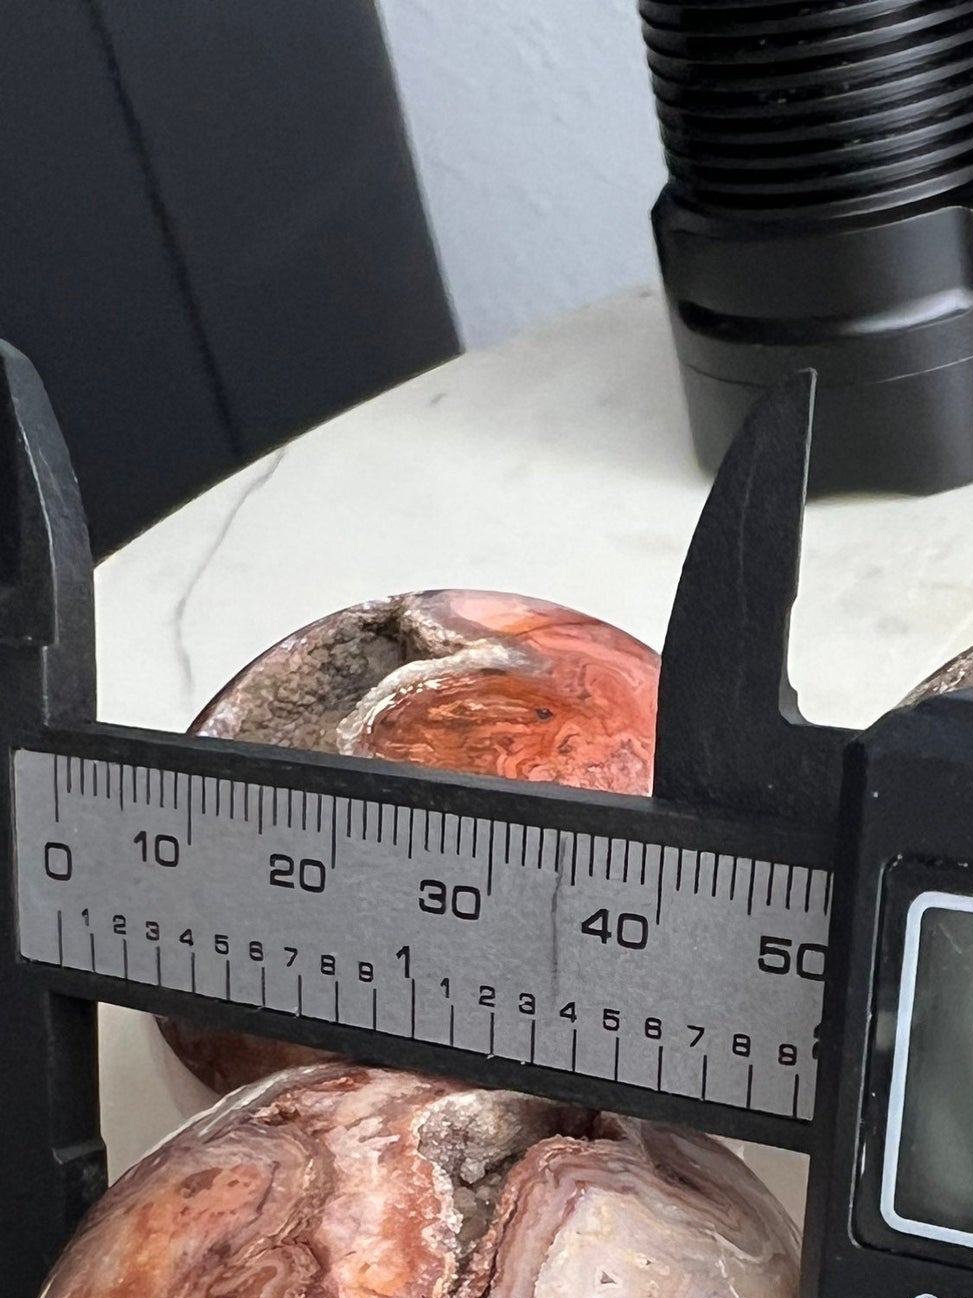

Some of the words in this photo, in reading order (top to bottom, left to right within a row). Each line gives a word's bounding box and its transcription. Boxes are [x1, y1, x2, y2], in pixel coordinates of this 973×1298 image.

[43, 841, 73, 882] 0
[133, 830, 180, 868] 10
[268, 853, 327, 893] 20
[418, 878, 482, 921] 30
[580, 907, 649, 950] 40
[757, 935, 830, 982] 50
[80, 907, 91, 927] 1
[112, 914, 127, 935] 2
[145, 920, 161, 941] 3
[178, 928, 195, 948] 4
[213, 933, 231, 956] 5
[248, 940, 265, 962] 6
[283, 946, 299, 968] 7
[319, 953, 337, 976] 8
[357, 961, 375, 983] 9
[395, 945, 412, 979] 1
[439, 977, 451, 999] 1
[478, 985, 496, 1008] 2
[518, 993, 536, 1015] 3
[559, 1001, 577, 1024] 4
[602, 1008, 621, 1031] 5
[643, 1017, 663, 1040] 6
[686, 1024, 706, 1048] 7
[732, 1033, 752, 1058] 8
